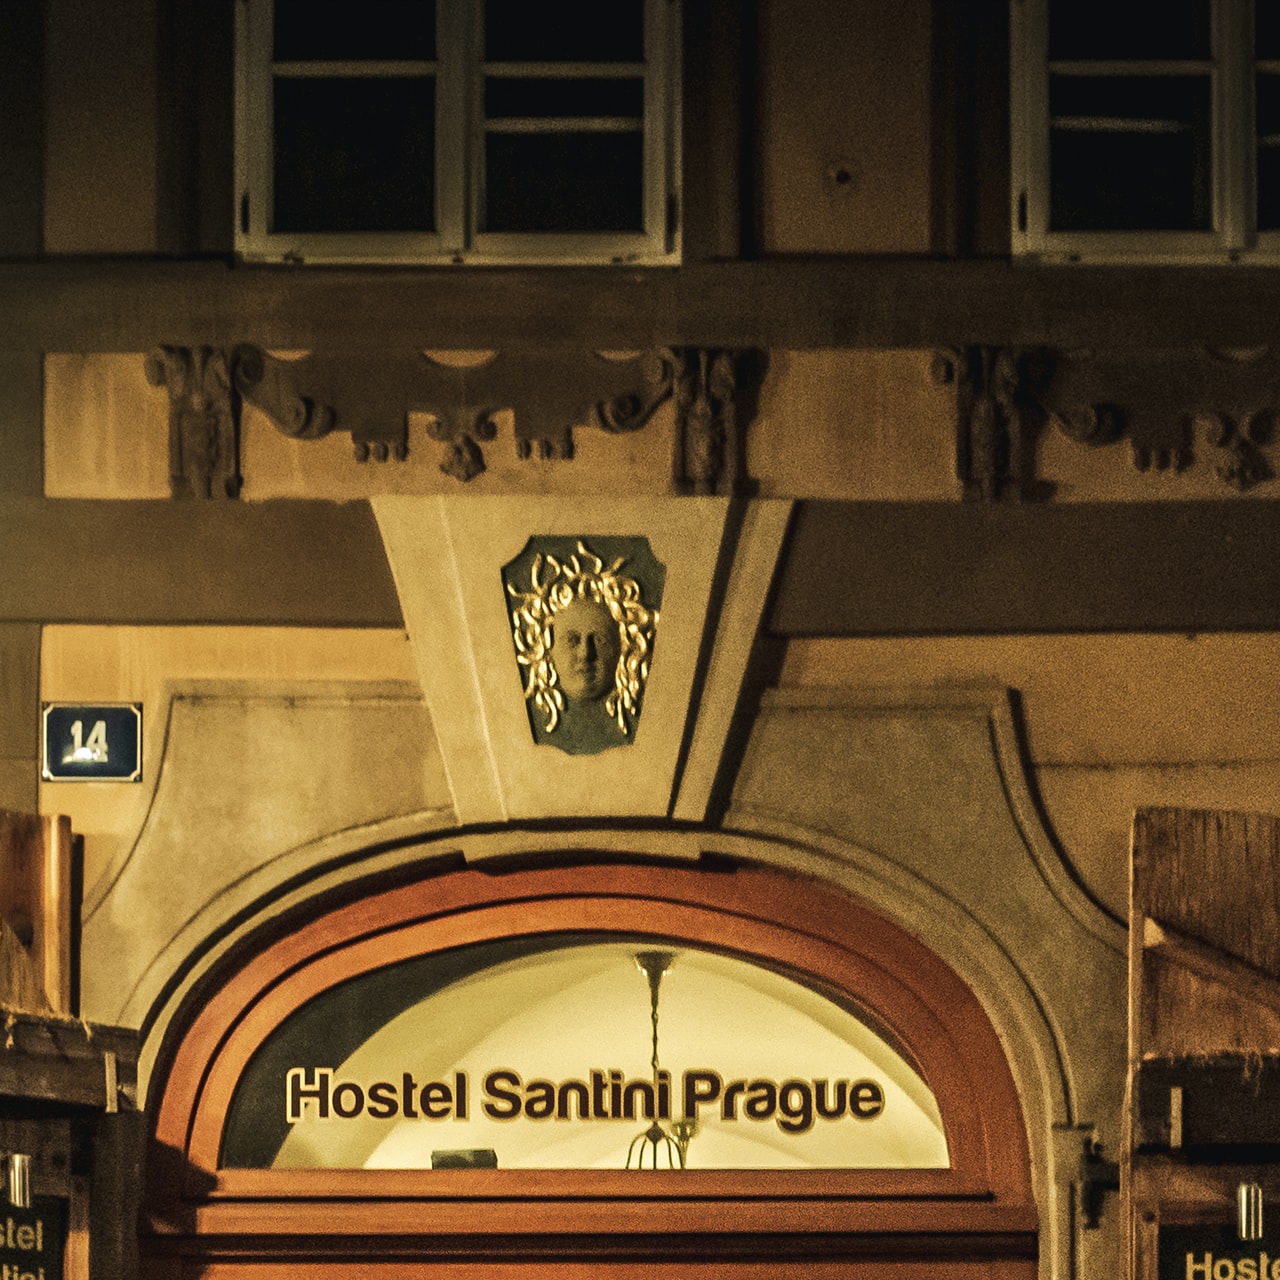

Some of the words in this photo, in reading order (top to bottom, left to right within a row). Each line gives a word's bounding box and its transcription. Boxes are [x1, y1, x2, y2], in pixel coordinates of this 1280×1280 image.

[70, 719, 109, 763] 14
[287, 1069, 469, 1122] Hostel
[482, 1069, 670, 1122] Santini
[683, 1069, 886, 1134] Prague
